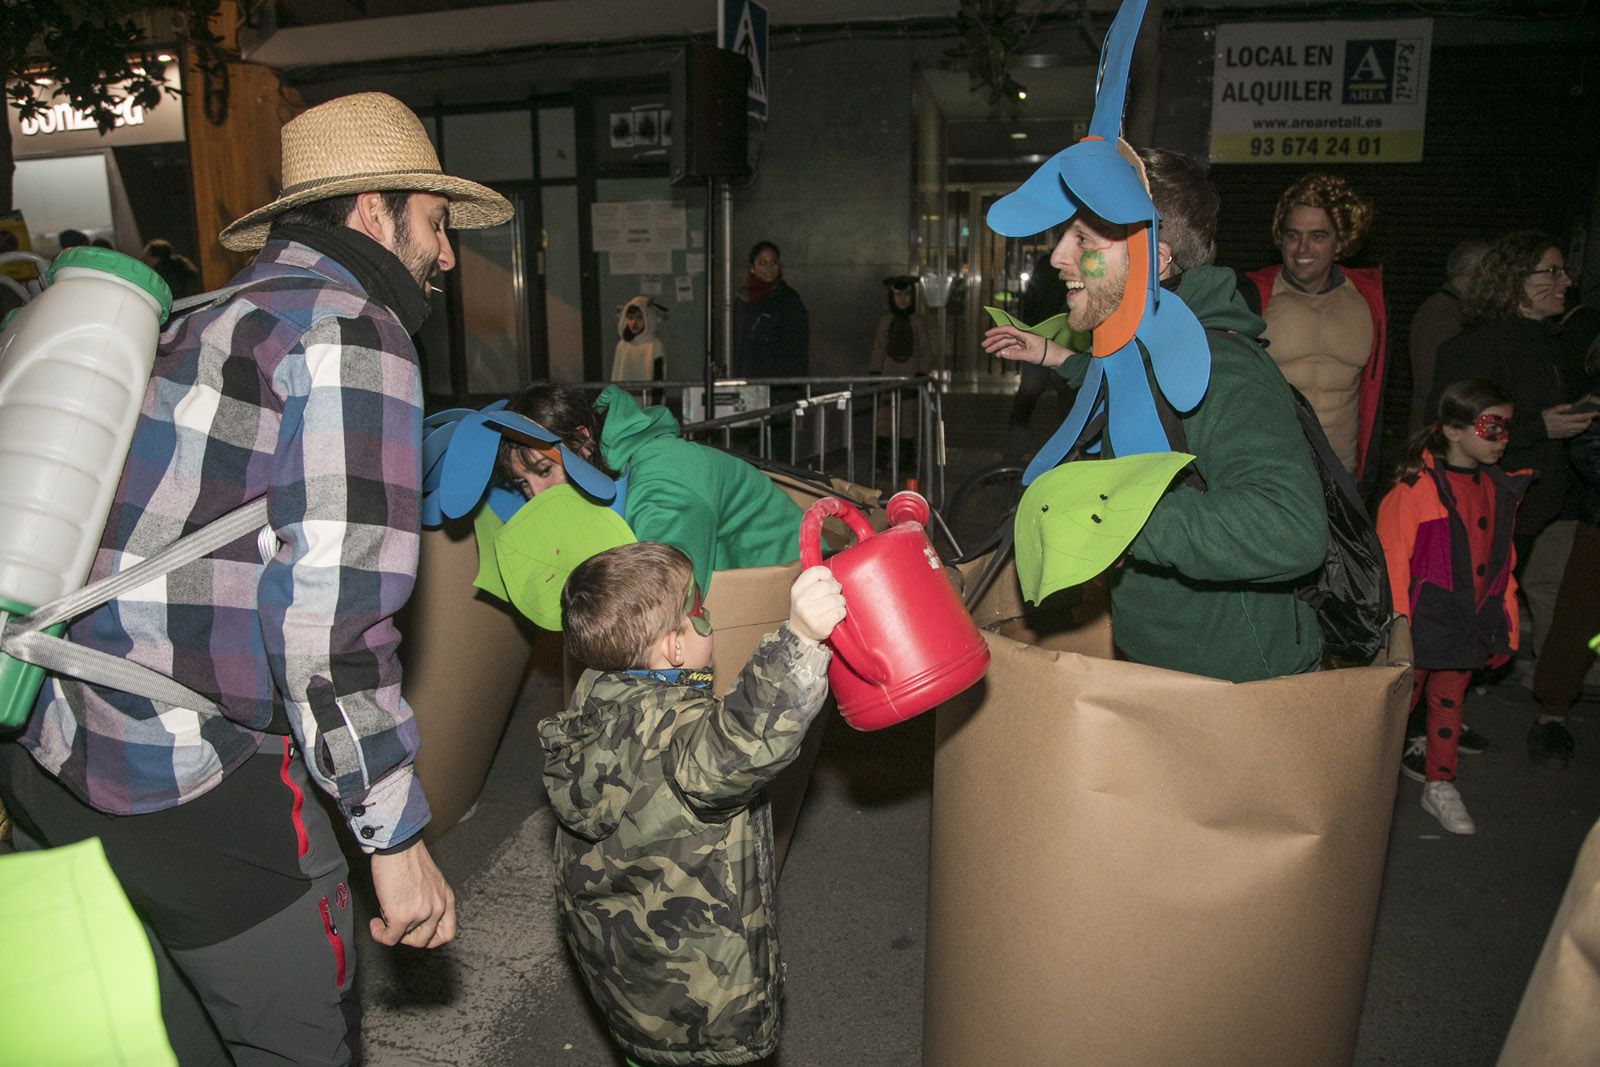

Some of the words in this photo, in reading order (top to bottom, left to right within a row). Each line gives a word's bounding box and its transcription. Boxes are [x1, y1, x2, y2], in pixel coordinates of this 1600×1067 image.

[1226, 45, 1297, 67] LOCAL
[1304, 45, 1333, 66] EN
[1396, 42, 1415, 100] Retail
[1221, 80, 1333, 105] ALQUILER
[1252, 116, 1383, 129] www.arearetail.es
[1250, 137, 1275, 156] 93
[1282, 137, 1319, 156] 674
[1326, 137, 1350, 156] 24
[1358, 136, 1382, 155] 01
